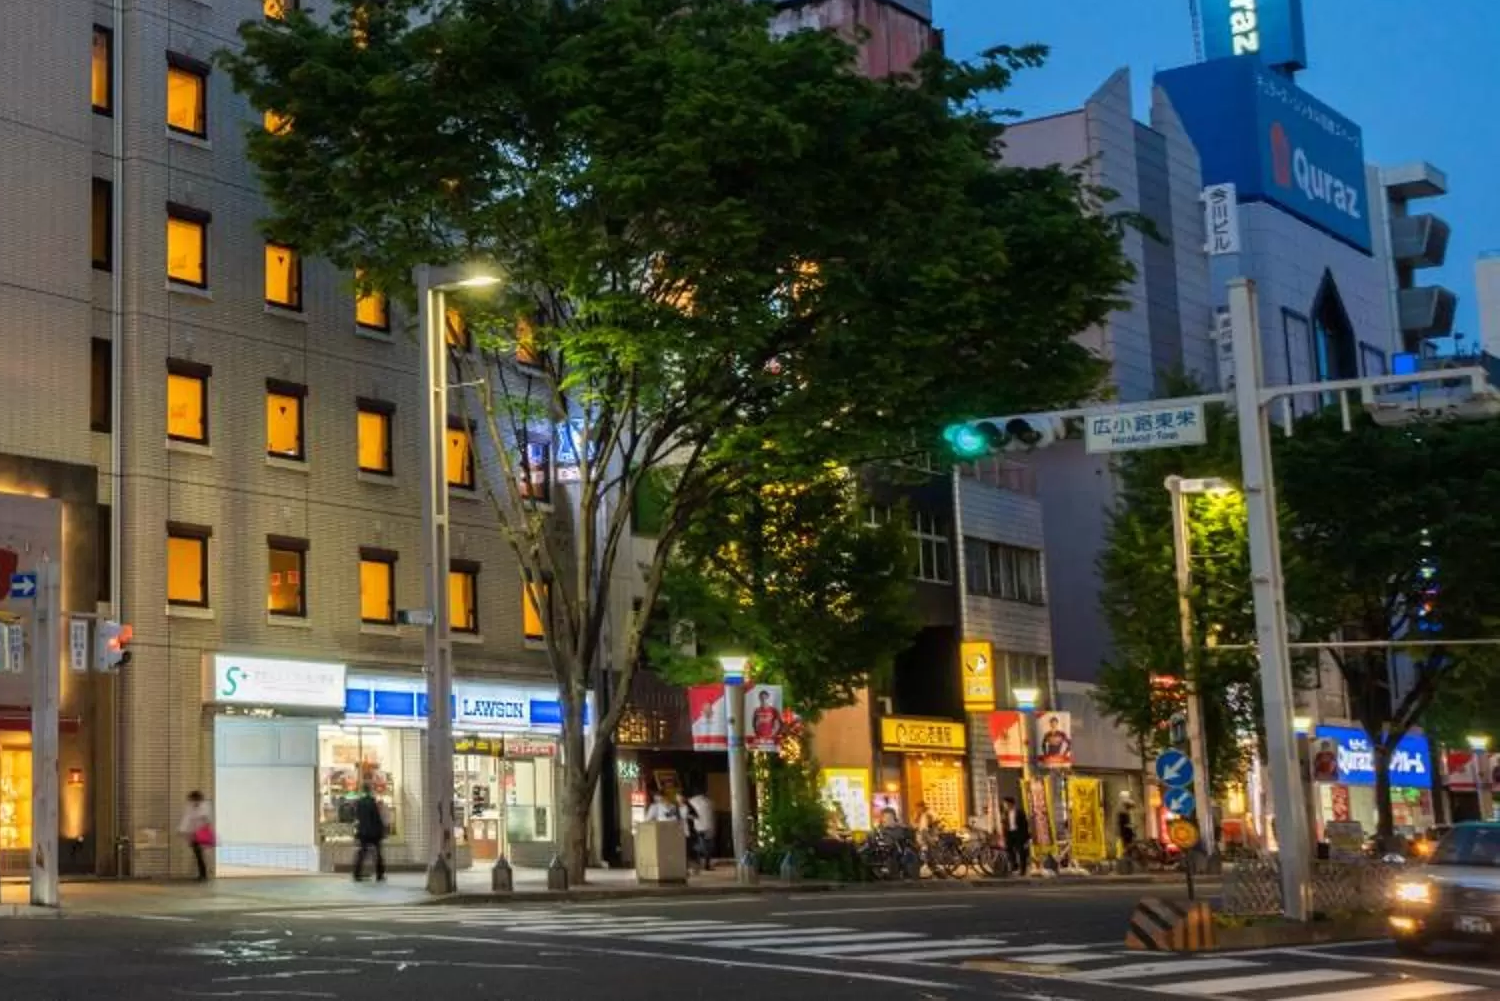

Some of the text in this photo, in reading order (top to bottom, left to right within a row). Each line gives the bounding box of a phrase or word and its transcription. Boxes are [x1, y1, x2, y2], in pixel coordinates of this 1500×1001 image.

[1292, 147, 1361, 219] Quraz
[1092, 407, 1198, 436] 広小路東栄
[463, 699, 524, 718] LAWSON
